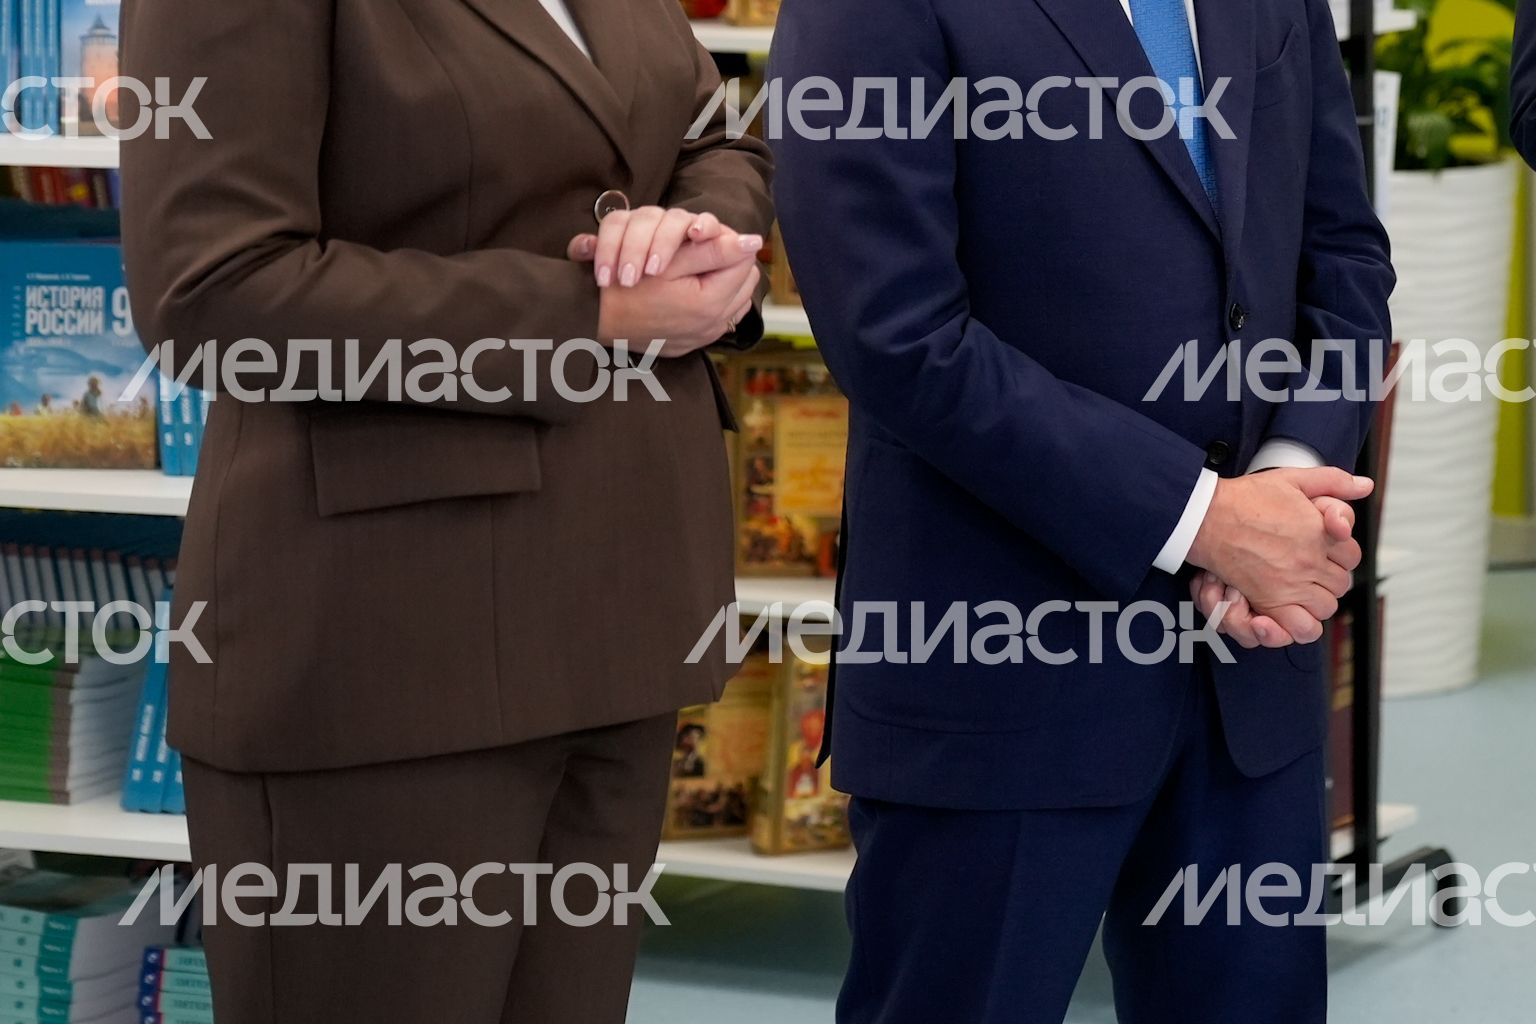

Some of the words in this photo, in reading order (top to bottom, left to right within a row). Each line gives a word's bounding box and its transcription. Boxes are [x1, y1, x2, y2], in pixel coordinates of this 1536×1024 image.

[25, 285, 105, 309] ИСТОРИЯ
[25, 308, 105, 336] РОССИИ
[111, 286, 133, 337] 9
